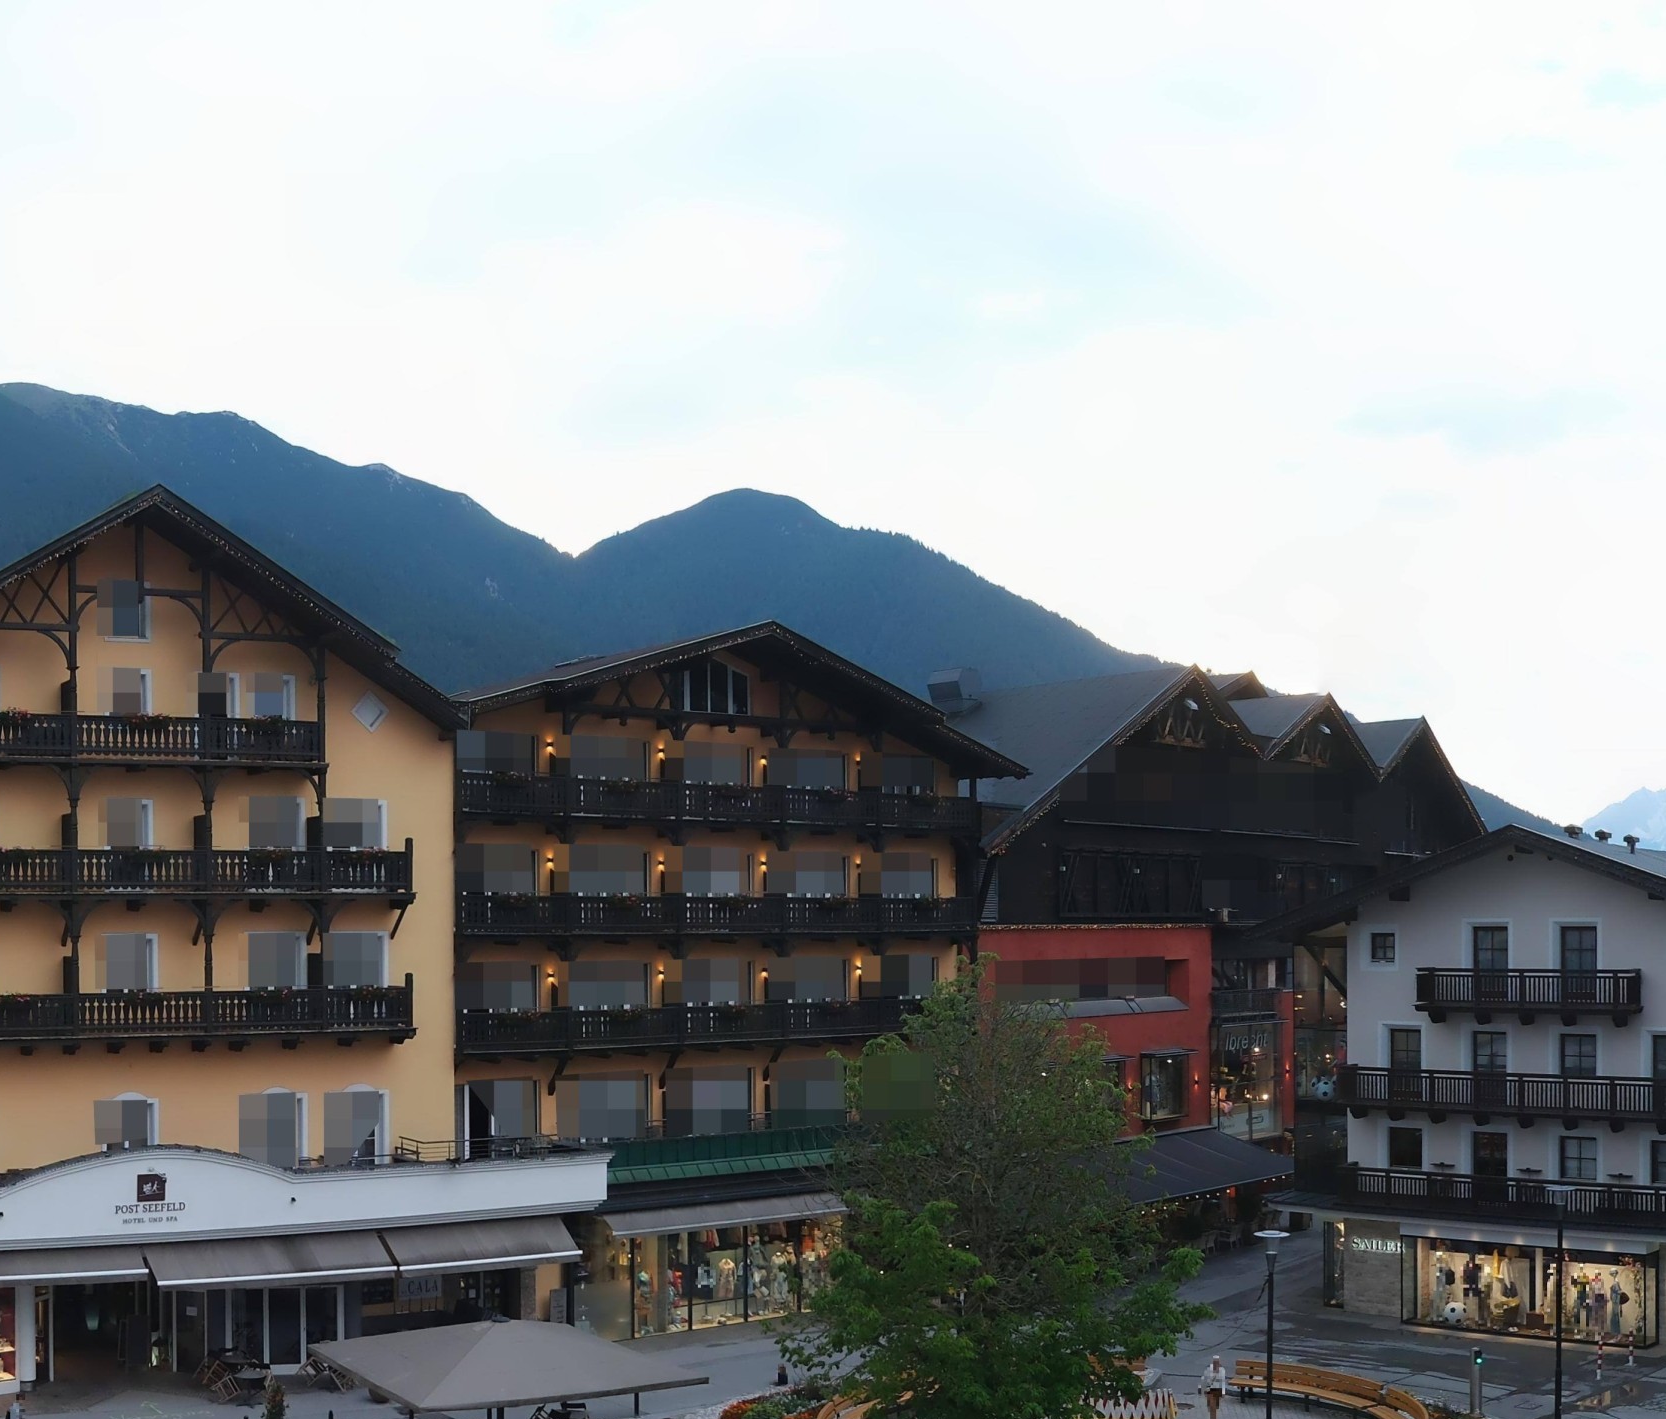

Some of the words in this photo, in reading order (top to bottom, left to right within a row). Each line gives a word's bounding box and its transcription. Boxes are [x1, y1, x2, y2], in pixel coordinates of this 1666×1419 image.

[115, 1204, 141, 1214] POST
[142, 1202, 186, 1213] SEEFELD
[122, 1217, 146, 1225] HOTEL
